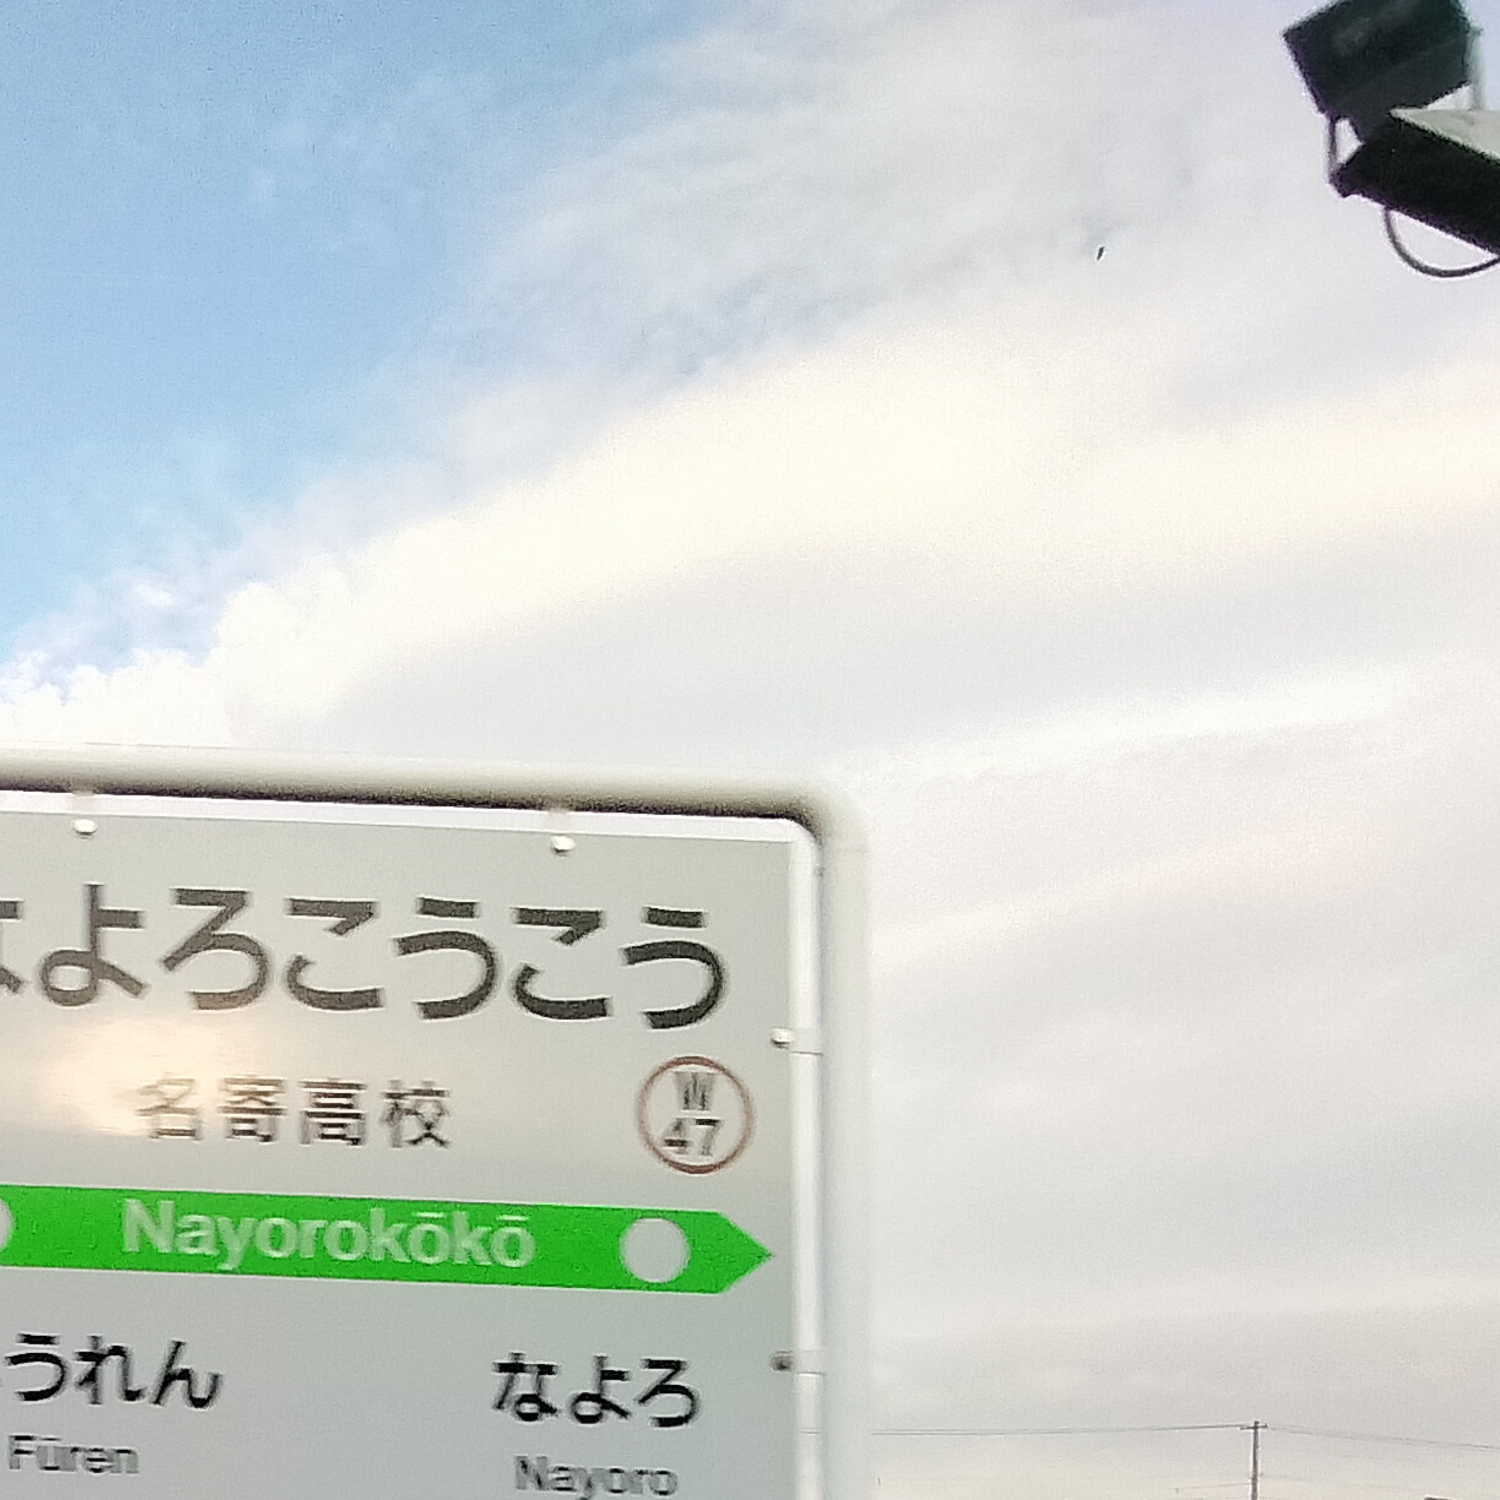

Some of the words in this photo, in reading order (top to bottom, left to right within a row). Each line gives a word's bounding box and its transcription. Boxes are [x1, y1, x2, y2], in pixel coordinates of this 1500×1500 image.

[137, 1074, 451, 1148] 名寄高校
[673, 1070, 714, 1111] W
[661, 1116, 722, 1156] 47
[122, 1199, 537, 1271] Nayorokōkō
[492, 1352, 701, 1427] なよろ
[9, 1434, 139, 1475] Fūren
[514, 1454, 677, 1500] Nayoro
